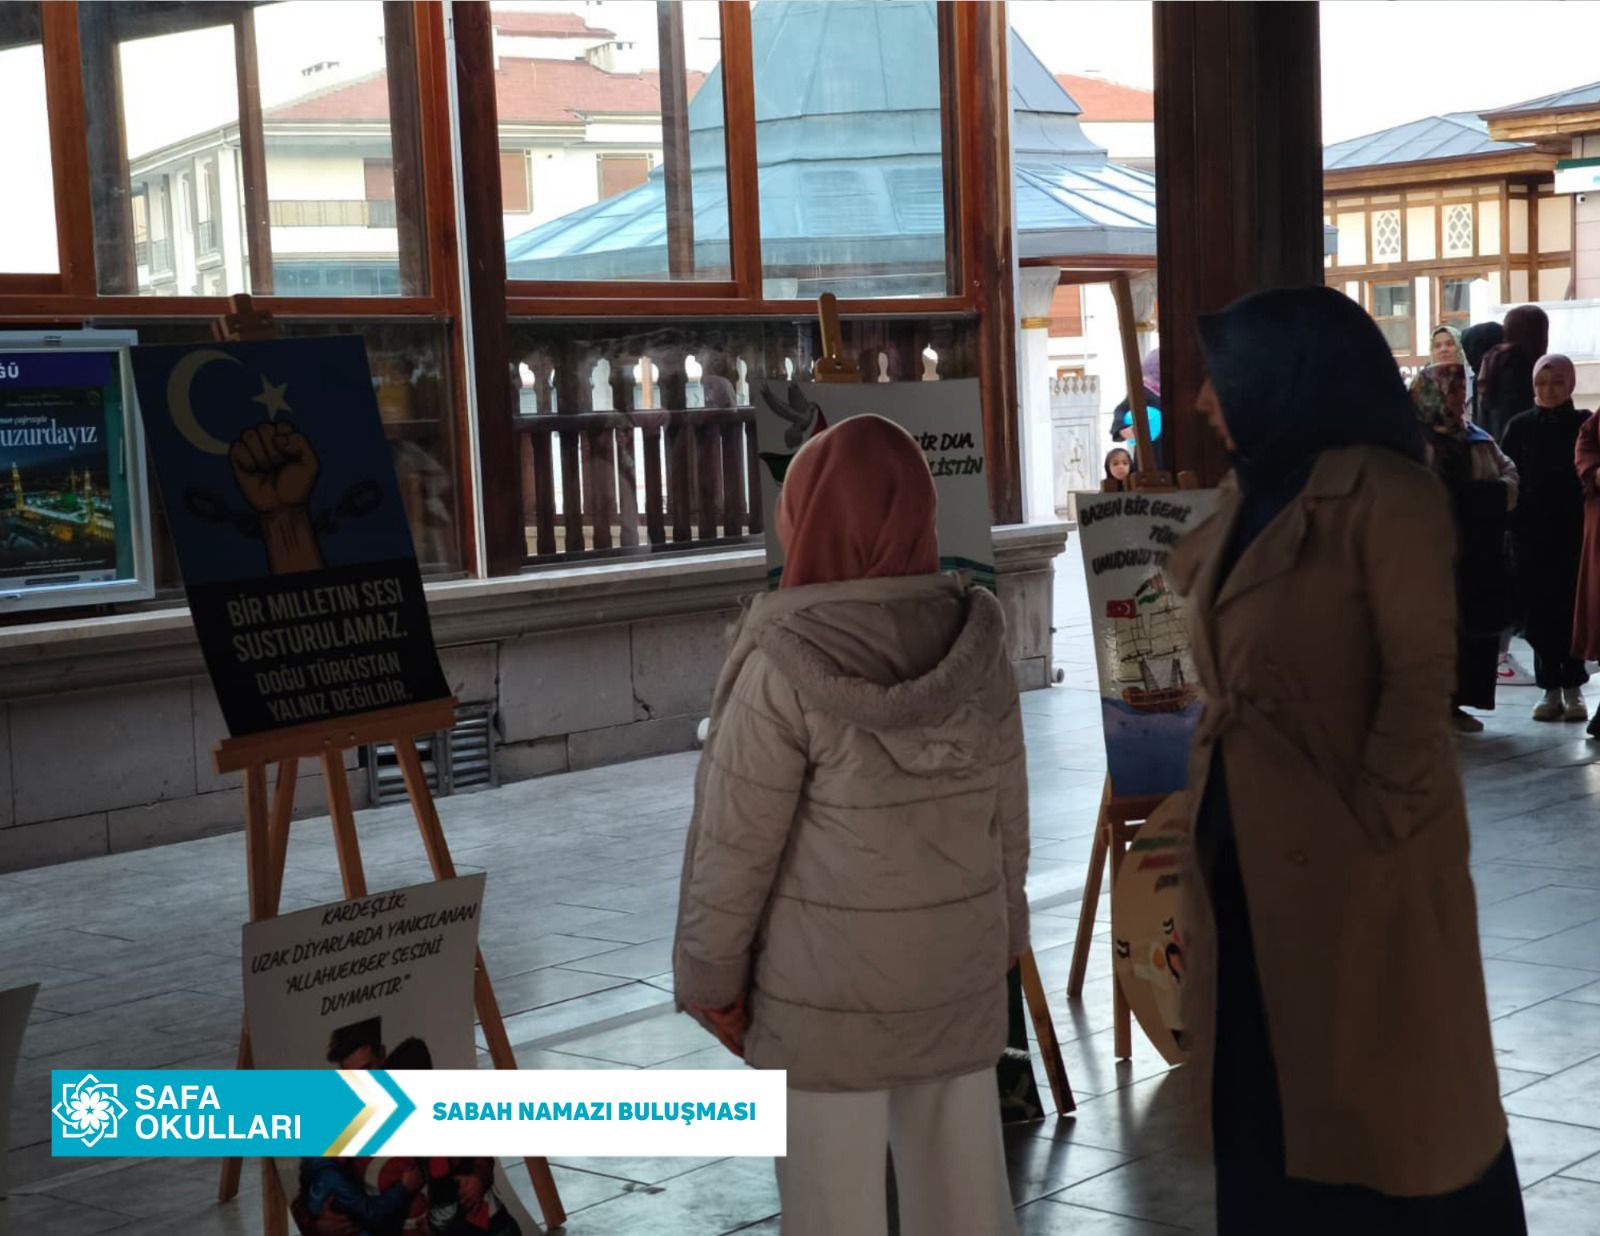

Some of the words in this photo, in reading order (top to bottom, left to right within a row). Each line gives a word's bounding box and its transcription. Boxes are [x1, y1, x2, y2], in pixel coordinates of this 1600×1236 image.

[926, 454, 983, 477] LİSTİN
[1080, 497, 1122, 527] BAZEN
[1124, 495, 1150, 517] BİR
[227, 593, 266, 627] BİR
[232, 611, 409, 662] SUSTURULAMAZ.
[255, 663, 306, 696] DOĞU
[306, 652, 401, 687] TÜRKİSTAN
[266, 692, 331, 721] YALNIZ
[251, 949, 290, 974] UZAK
[291, 925, 383, 964] DİYARLARDA
[388, 902, 477, 938] YANKILANAN
[391, 934, 444, 966] SESİNİ
